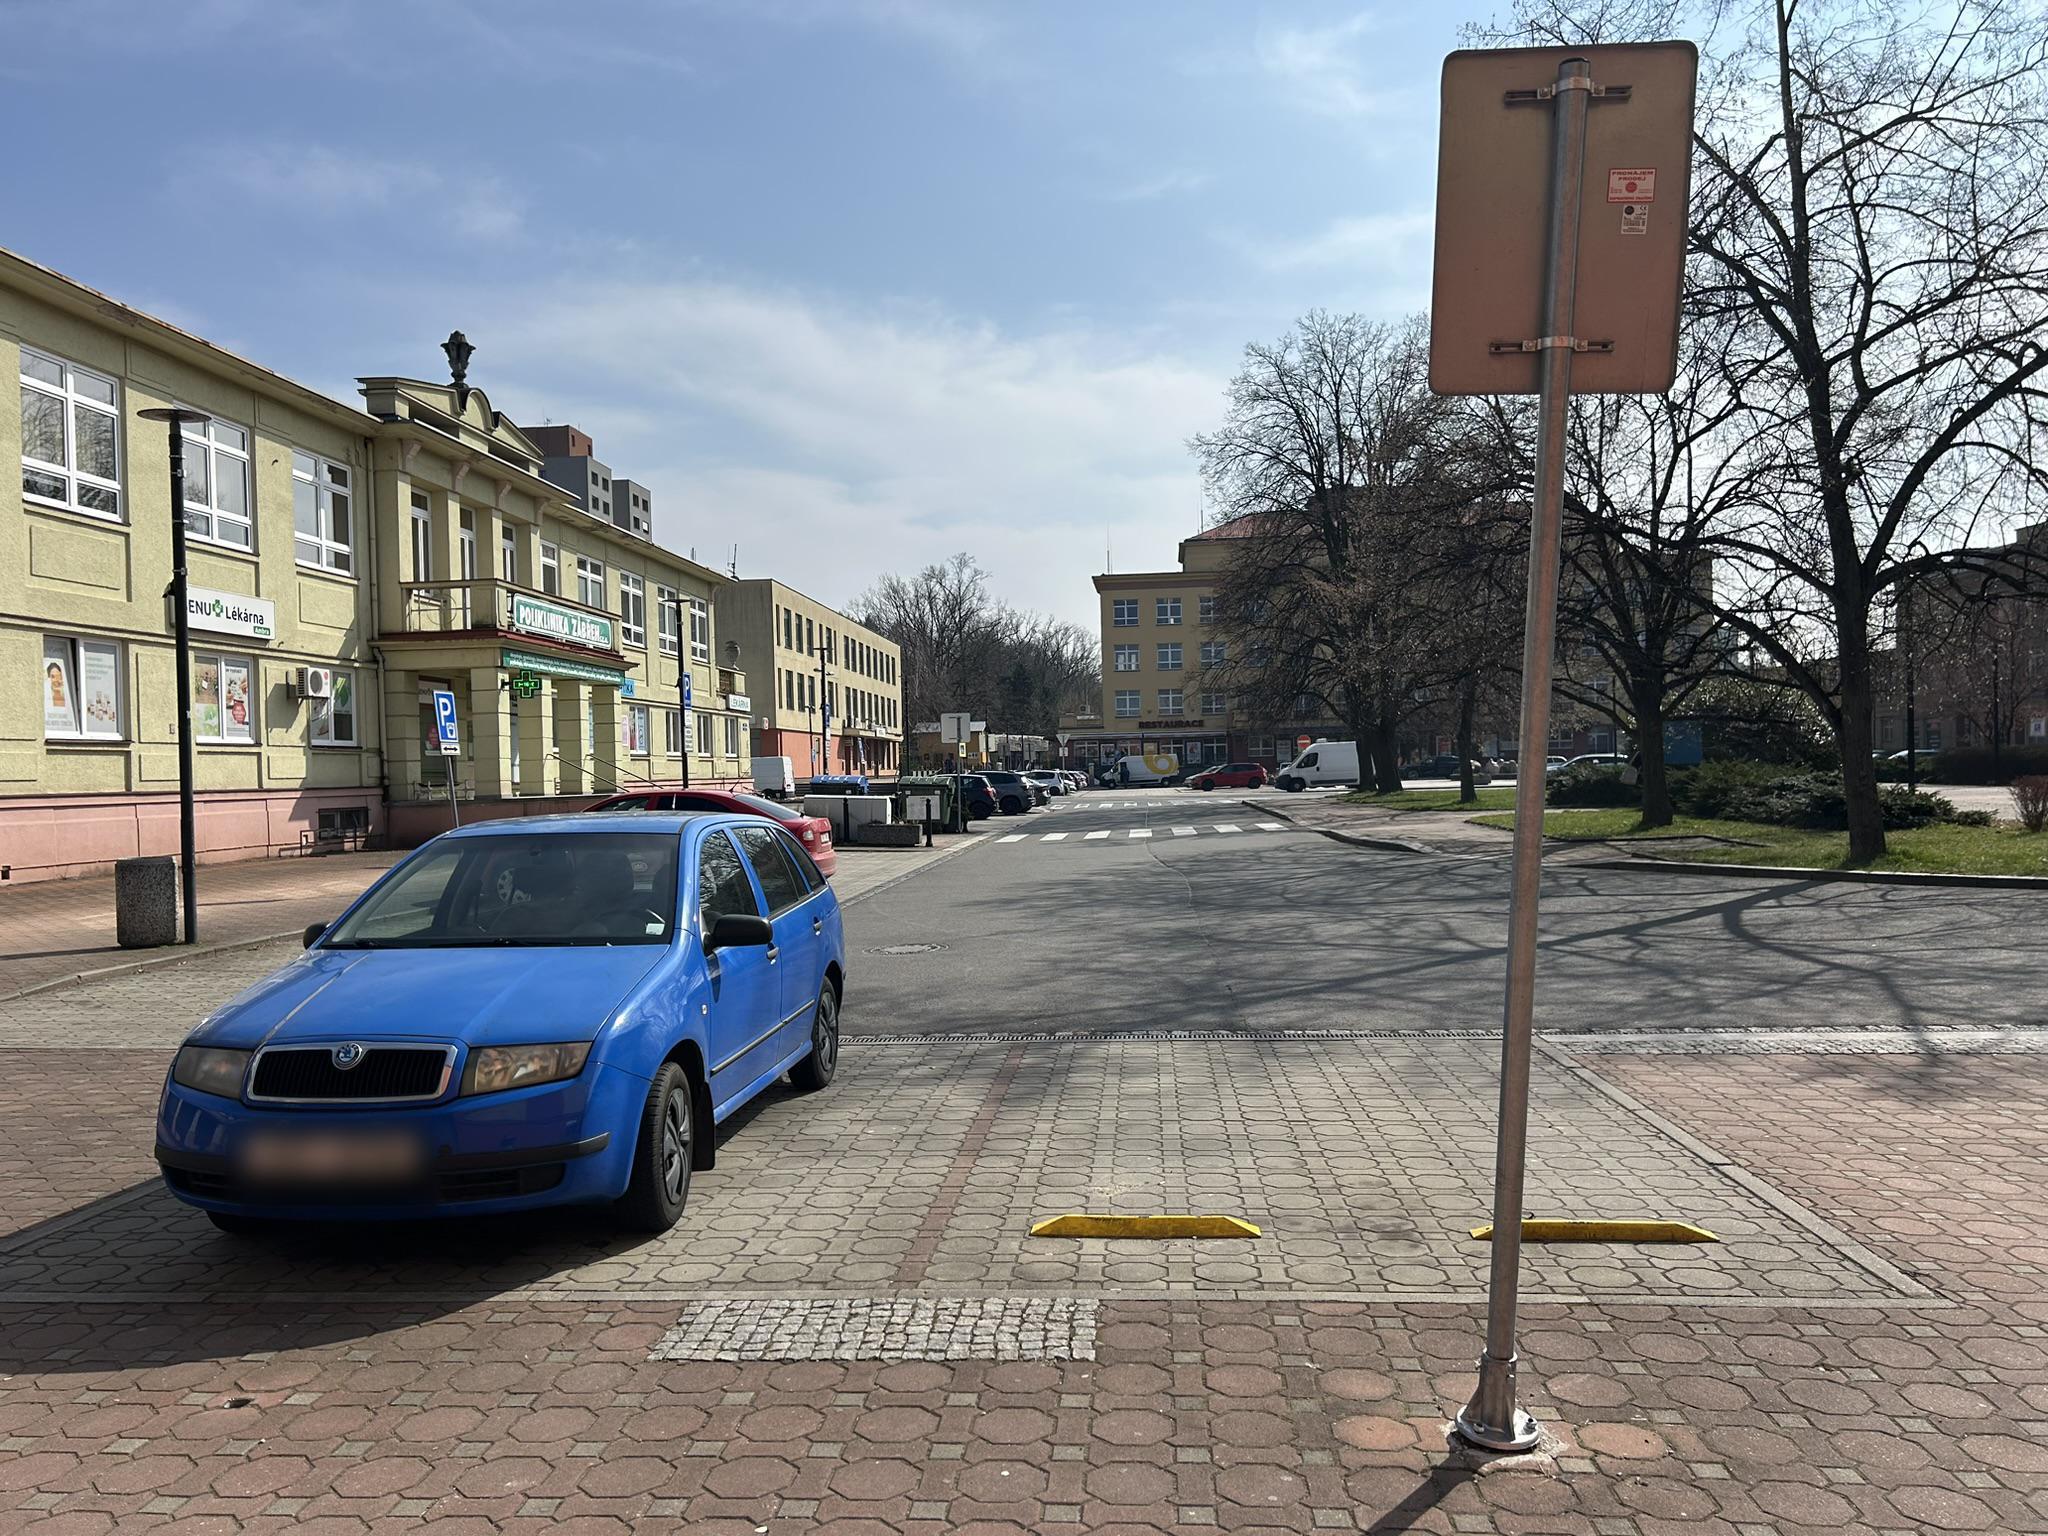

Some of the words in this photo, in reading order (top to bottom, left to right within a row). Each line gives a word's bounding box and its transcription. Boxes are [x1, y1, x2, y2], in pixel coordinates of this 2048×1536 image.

[188, 599, 211, 616] ENU
[225, 606, 264, 625] Lékárna
[518, 603, 569, 635] POLIKLINIKA
[571, 614, 600, 641] ZÁBŘEH
[1138, 719, 1205, 729] RESTAURACE
